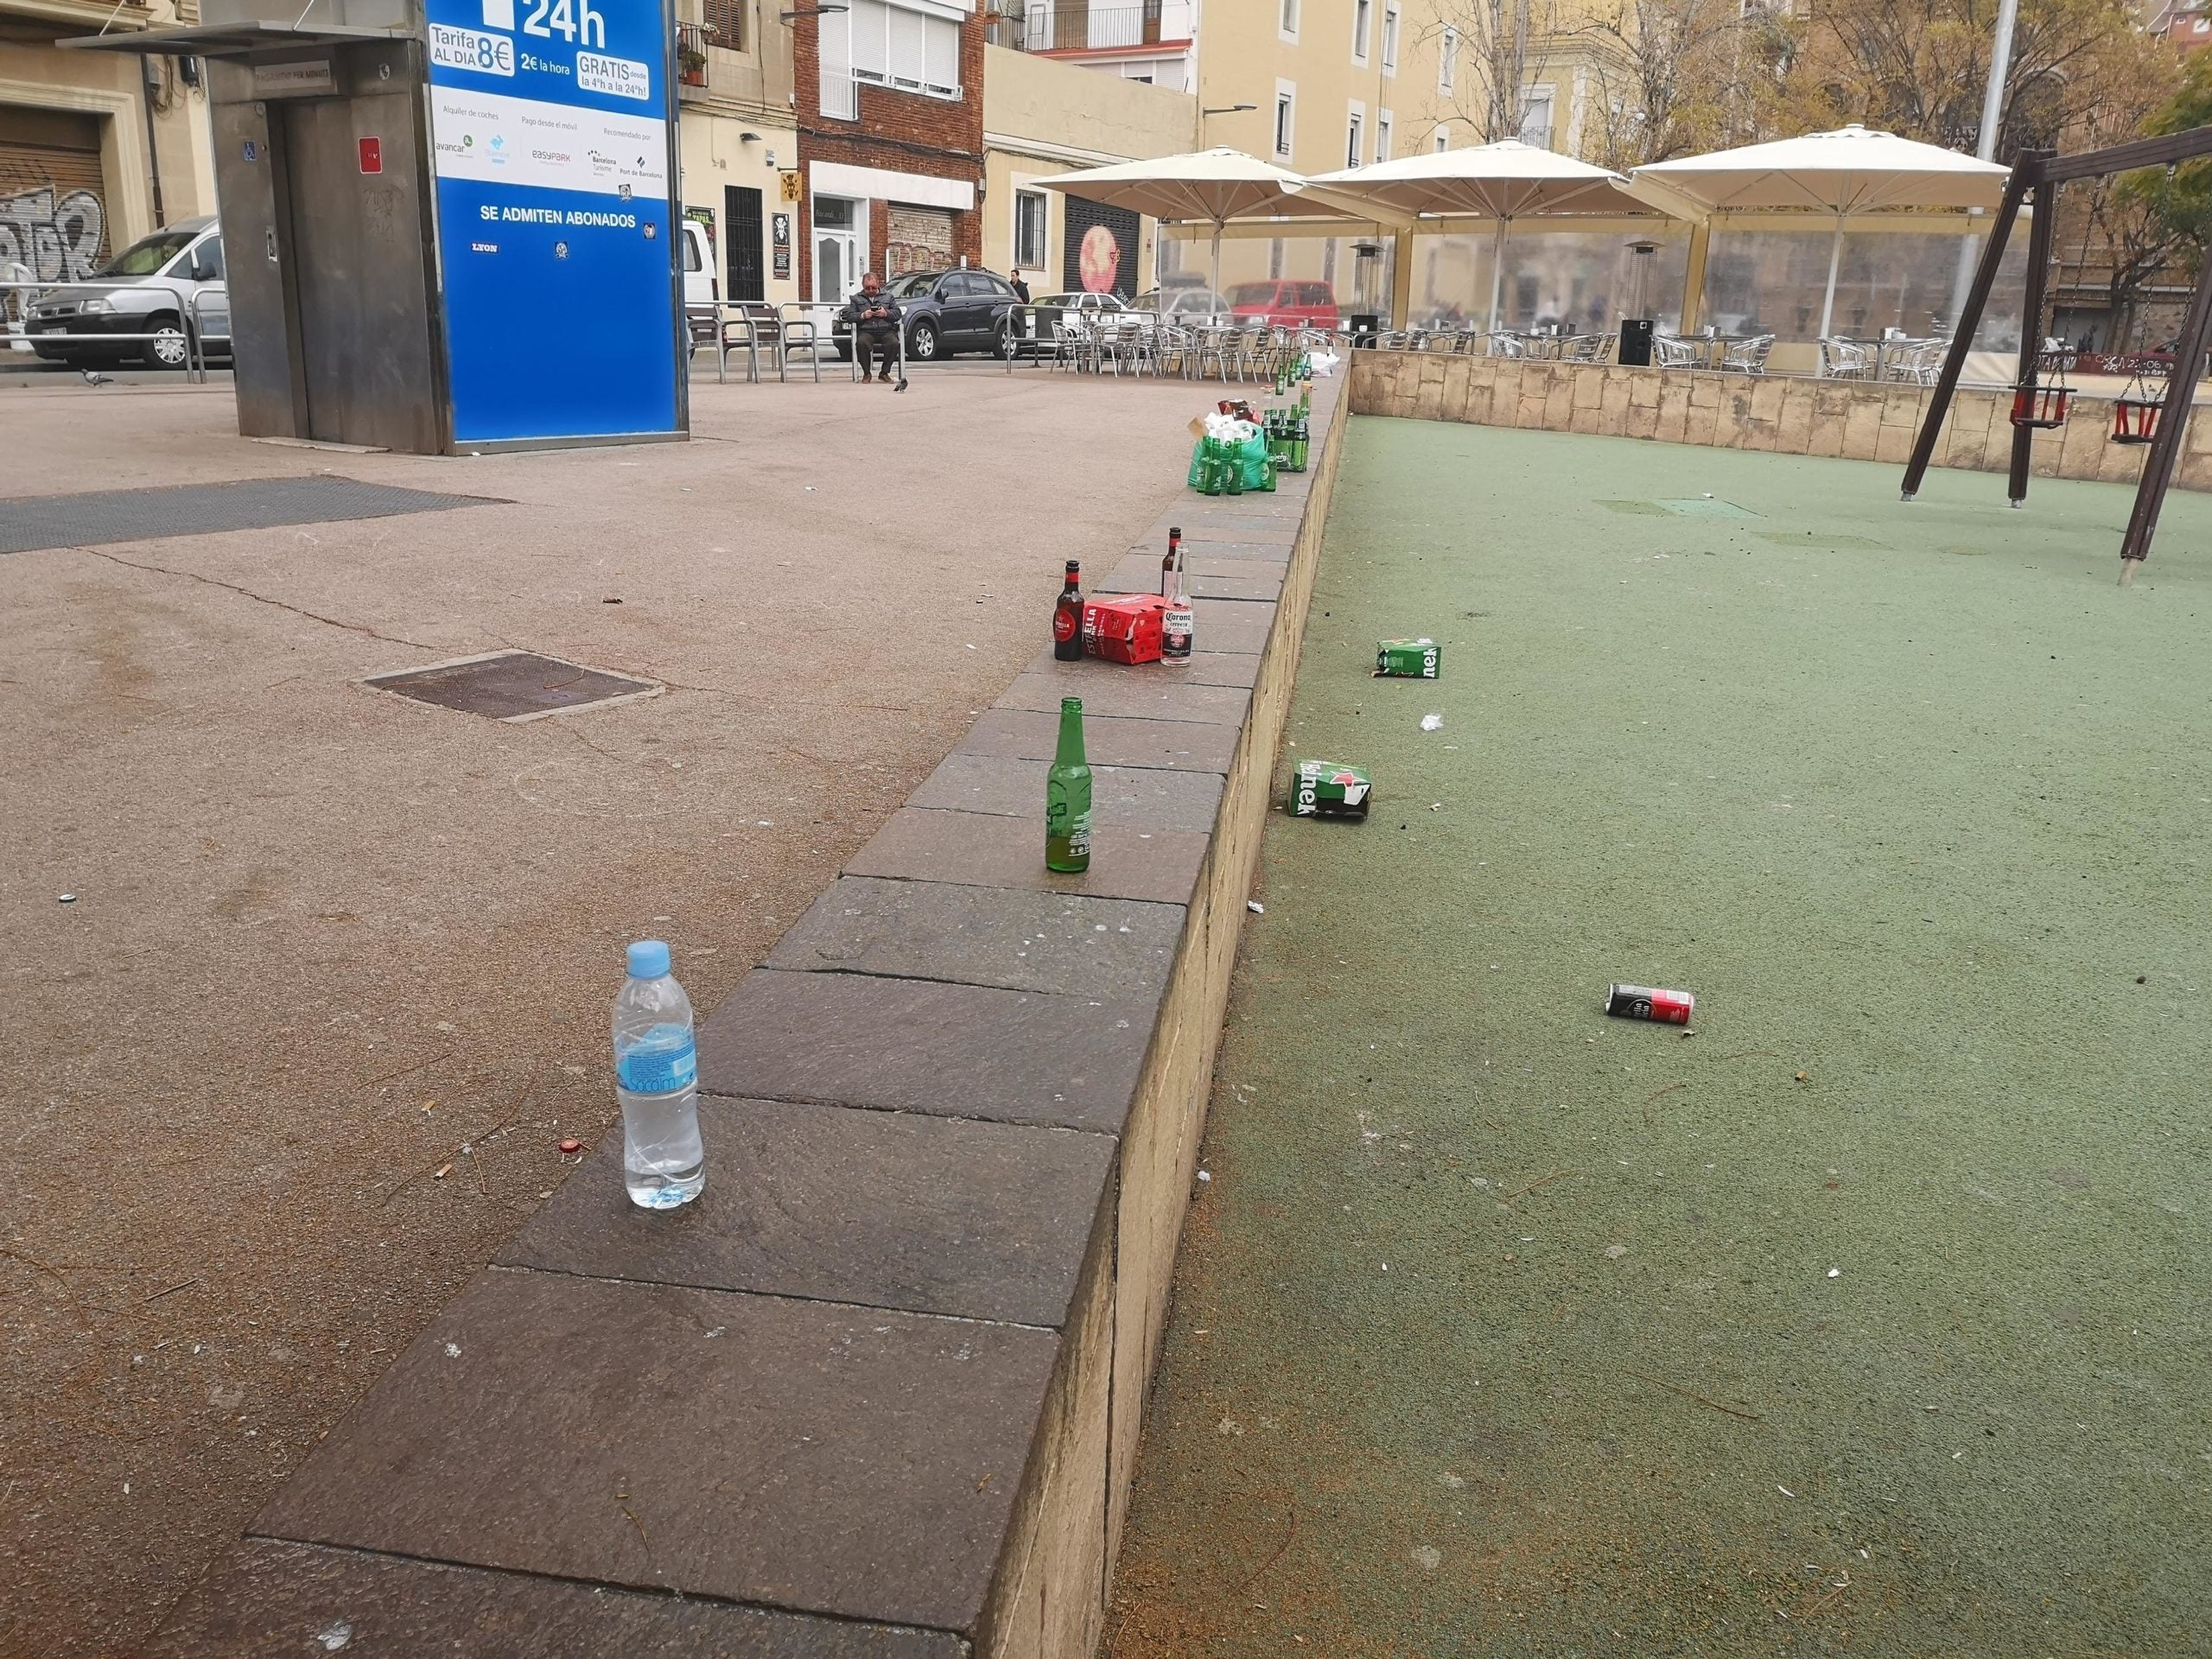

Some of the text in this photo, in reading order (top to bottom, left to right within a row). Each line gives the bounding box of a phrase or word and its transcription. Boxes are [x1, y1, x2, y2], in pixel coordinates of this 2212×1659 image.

[523, 0, 606, 48] 24h
[431, 27, 475, 49] Tarifa
[435, 48, 476, 66] AL DIA
[478, 36, 512, 71] 8€
[520, 53, 570, 75] 2€ la hora
[580, 55, 646, 80] GRATIS desde
[582, 75, 590, 86] la
[607, 81, 613, 91] a
[615, 81, 623, 92] la
[442, 105, 467, 116] Alquiler
[477, 111, 499, 120] coches
[521, 116, 537, 126] Pago
[537, 118, 555, 128] desde
[555, 120, 562, 129] el
[603, 127, 641, 140] Recomendado
[435, 142, 465, 153] avancar
[592, 156, 617, 165] Barcelona
[639, 170, 663, 179] Barcelona
[480, 205, 636, 228] SE ADMITEN ABONADOS
